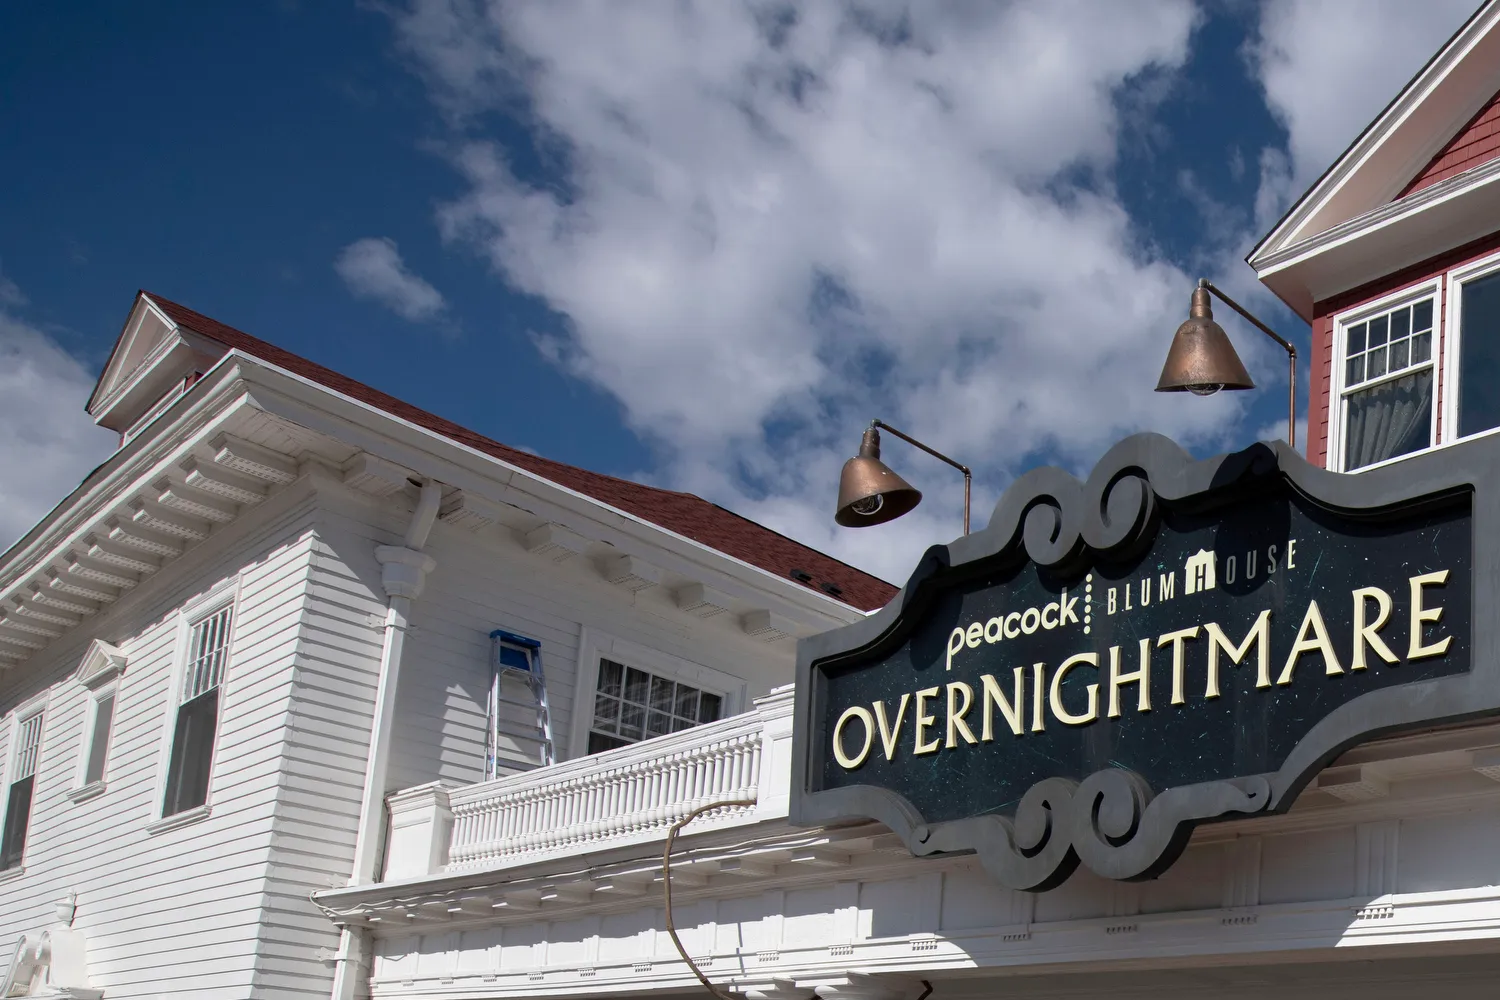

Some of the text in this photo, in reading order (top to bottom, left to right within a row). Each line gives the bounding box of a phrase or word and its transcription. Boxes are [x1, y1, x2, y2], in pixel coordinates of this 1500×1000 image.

[832, 569, 1453, 770] OVERNIGHTMARE
[946, 539, 1297, 671] peacock BLUMHOUSE
